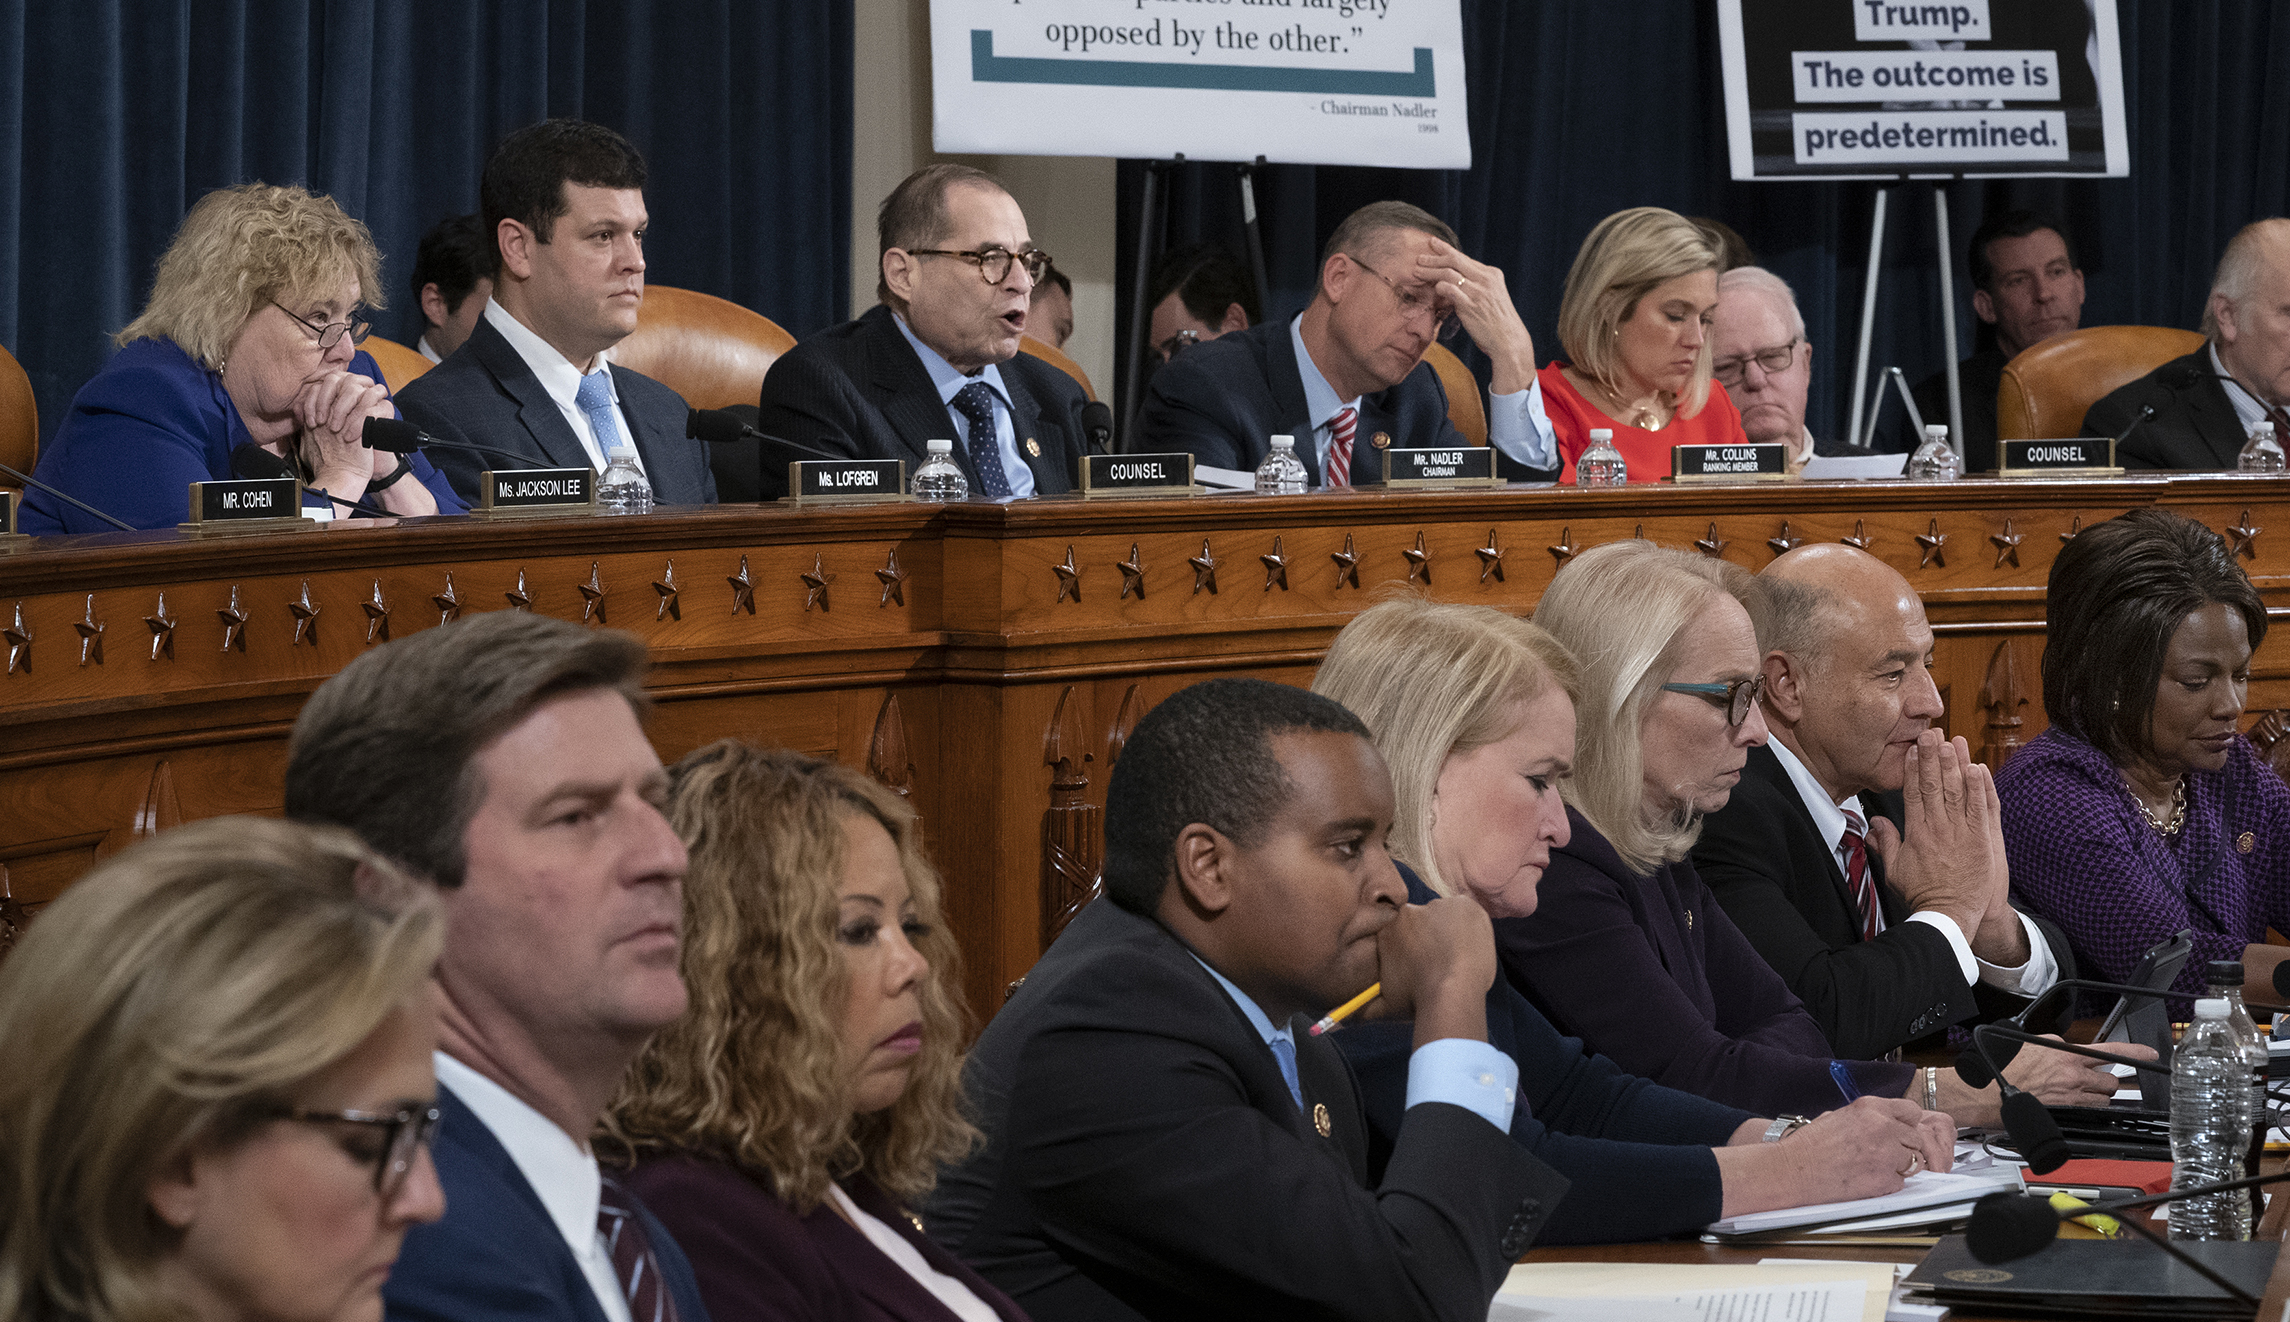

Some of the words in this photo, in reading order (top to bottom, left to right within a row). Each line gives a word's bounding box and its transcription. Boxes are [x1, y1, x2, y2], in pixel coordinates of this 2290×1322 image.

[1865, 0, 1977, 33] Trump.
[1046, 18, 1161, 51] opposed
[1173, 19, 1204, 55] by
[1216, 22, 1258, 49] the
[1270, 24, 1362, 52] other.”
[1804, 61, 1864, 87] The
[1873, 62, 2015, 87] outcome
[2023, 60, 2048, 86] is
[1321, 100, 1388, 116] Chairman
[1393, 103, 1437, 118] Nadler
[1806, 120, 2057, 156] predetermined.
[1431, 452, 1463, 464] NADLER
[1721, 448, 1756, 460] COLLINS
[2028, 447, 2085, 461] COUNSEL
[1111, 463, 1166, 479] COUNSEL
[1423, 467, 1455, 476] CHAIRMAN
[1703, 462, 1731, 472] RANKING
[1732, 462, 1758, 471] MEMBER
[819, 472, 833, 486] Ms.
[837, 471, 878, 486] LOFGREN
[500, 482, 514, 497] Ms.
[516, 481, 560, 497] JACKSON
[563, 480, 580, 495] LEE
[224, 493, 240, 508] MR.
[243, 491, 271, 508] COHEN
